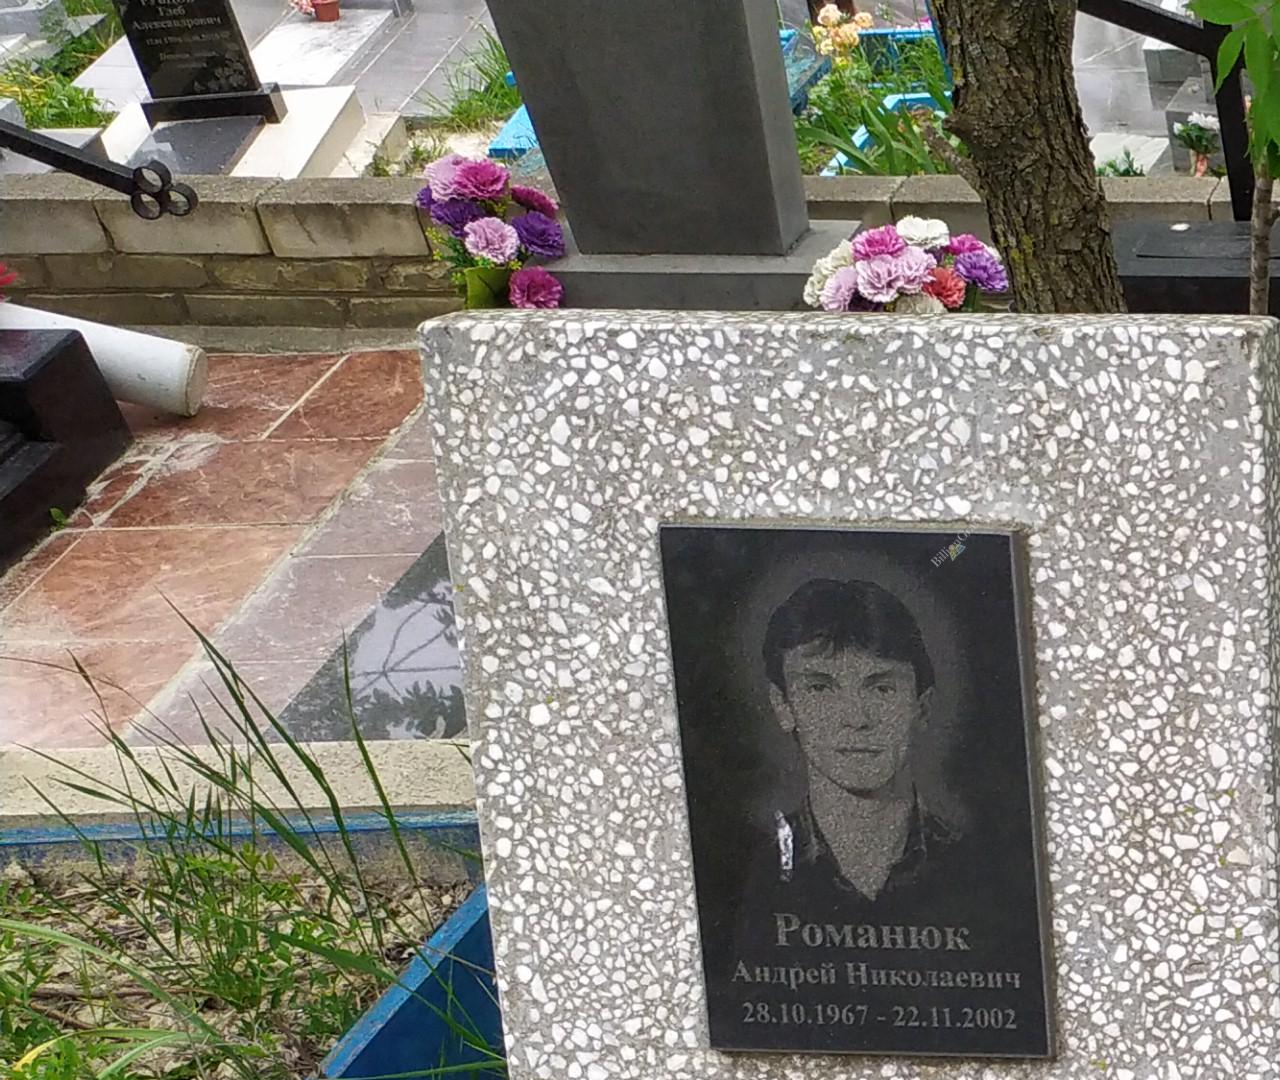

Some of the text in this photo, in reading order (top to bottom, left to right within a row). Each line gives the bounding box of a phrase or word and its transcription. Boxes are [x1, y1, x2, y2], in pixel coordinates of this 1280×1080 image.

[773, 912, 971, 951] Романюк
[731, 959, 1022, 990] Андрей Николаевич
[742, 1001, 869, 1026] 28.10.1967
[892, 1004, 1018, 1029] 22.11.2002
